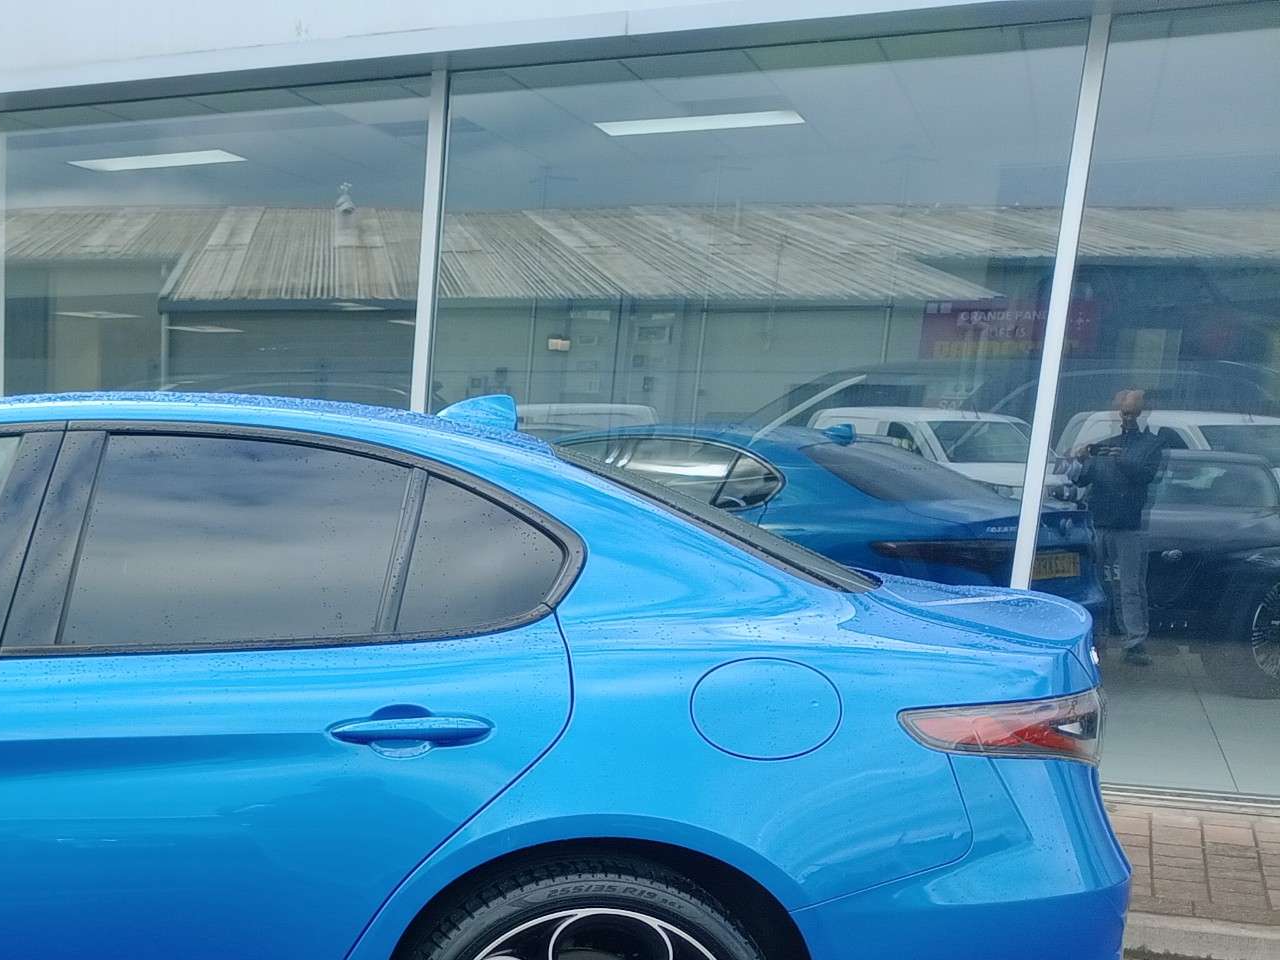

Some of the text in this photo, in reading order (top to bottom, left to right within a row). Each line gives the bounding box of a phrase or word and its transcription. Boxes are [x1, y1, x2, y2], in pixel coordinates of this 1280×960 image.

[959, 310, 1012, 321] GRANDE
[546, 884, 618, 899] 255/35
[622, 886, 658, 900] R19
